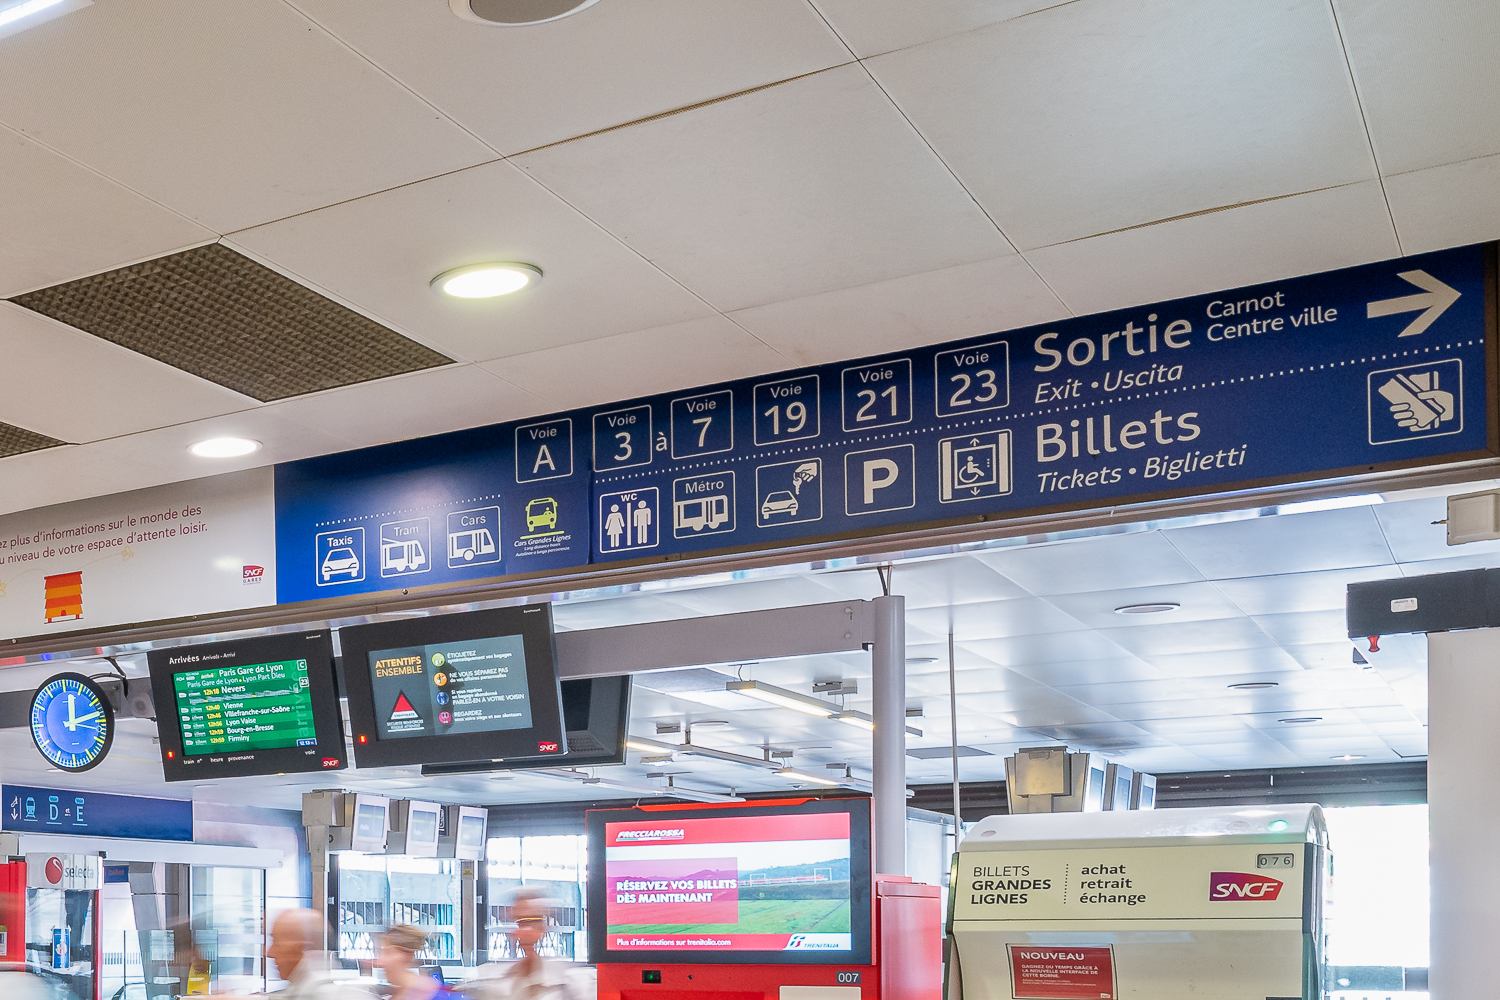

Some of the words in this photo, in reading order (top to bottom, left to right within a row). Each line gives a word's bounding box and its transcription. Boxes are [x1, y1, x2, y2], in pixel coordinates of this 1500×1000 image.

[1206, 291, 1285, 320] Carnot
[1206, 315, 1284, 343] Centre
[1290, 305, 1338, 327] ville
[1033, 312, 1193, 373] Sortie
[953, 350, 989, 367] Voie
[859, 367, 894, 383] Voie
[770, 383, 803, 399] Voie
[950, 369, 998, 407] 23
[1034, 379, 1083, 404] Exit
[1102, 364, 1184, 393] Uscita
[686, 397, 717, 413] Voie
[855, 385, 898, 422] 21
[607, 412, 637, 428] Voie
[764, 401, 808, 436] 19
[529, 426, 558, 440] Voie
[692, 416, 713, 448] 7
[1035, 408, 1201, 464] Billets
[614, 432, 633, 462] 3
[655, 431, 668, 452] à
[532, 444, 556, 474] A
[1037, 467, 1122, 494] Tickets
[1143, 444, 1248, 481] Biglietti
[684, 478, 725, 494] Métro
[863, 458, 899, 505] P
[620, 491, 638, 502] WC
[460, 513, 487, 527] Cars
[10, 533, 31, 551] plus
[33, 521, 106, 545] d'informations
[108, 518, 124, 531] sur
[126, 515, 137, 528] le
[139, 508, 179, 525] monde
[181, 504, 202, 519] des
[393, 524, 419, 537] Tram
[7, 546, 41, 565] niveau
[42, 544, 56, 559] de
[58, 541, 85, 556] votre
[86, 534, 123, 553] espace
[126, 527, 177, 546] d'attente
[179, 520, 208, 537] loisir.
[326, 535, 354, 548] Taxis
[528, 537, 552, 546] Grandes
[553, 534, 571, 543] Lignes
[243, 567, 264, 579] SNCF
[169, 655, 200, 665] Arrivées
[375, 656, 421, 669] ATTENTIFS
[218, 669, 237, 677] Paris
[237, 667, 254, 675] Gare
[255, 665, 265, 673] de
[265, 664, 284, 674] Lyon
[376, 665, 423, 678] ENSEMBLE
[221, 685, 246, 694] Nevers
[223, 702, 244, 710] Vienne
[224, 706, 290, 718] Villefranche-sur-Saône
[225, 718, 240, 726] Lyon
[227, 724, 274, 734] Bourg-en-Bresse
[617, 829, 684, 839] FRECCIAROSSA
[64, 865, 95, 879] selecta
[973, 865, 1030, 877] BILLETS
[1081, 864, 1126, 875] achat
[616, 880, 669, 891] RÉSERVEZ
[670, 880, 694, 890] VOS
[696, 879, 737, 890] BILLETS
[971, 879, 1051, 891] GRANDES
[1080, 877, 1132, 889] retrait
[1212, 881, 1279, 898] SNCF
[616, 892, 636, 904] DÈS
[638, 892, 713, 903] MAINTENANT
[971, 893, 1028, 905] LIGNES
[1079, 892, 1147, 906] échange
[617, 938, 630, 946] Plus
[687, 938, 732, 946] trenitalia.com
[1020, 952, 1085, 961] NOUVEAU
[838, 973, 859, 983] 007
